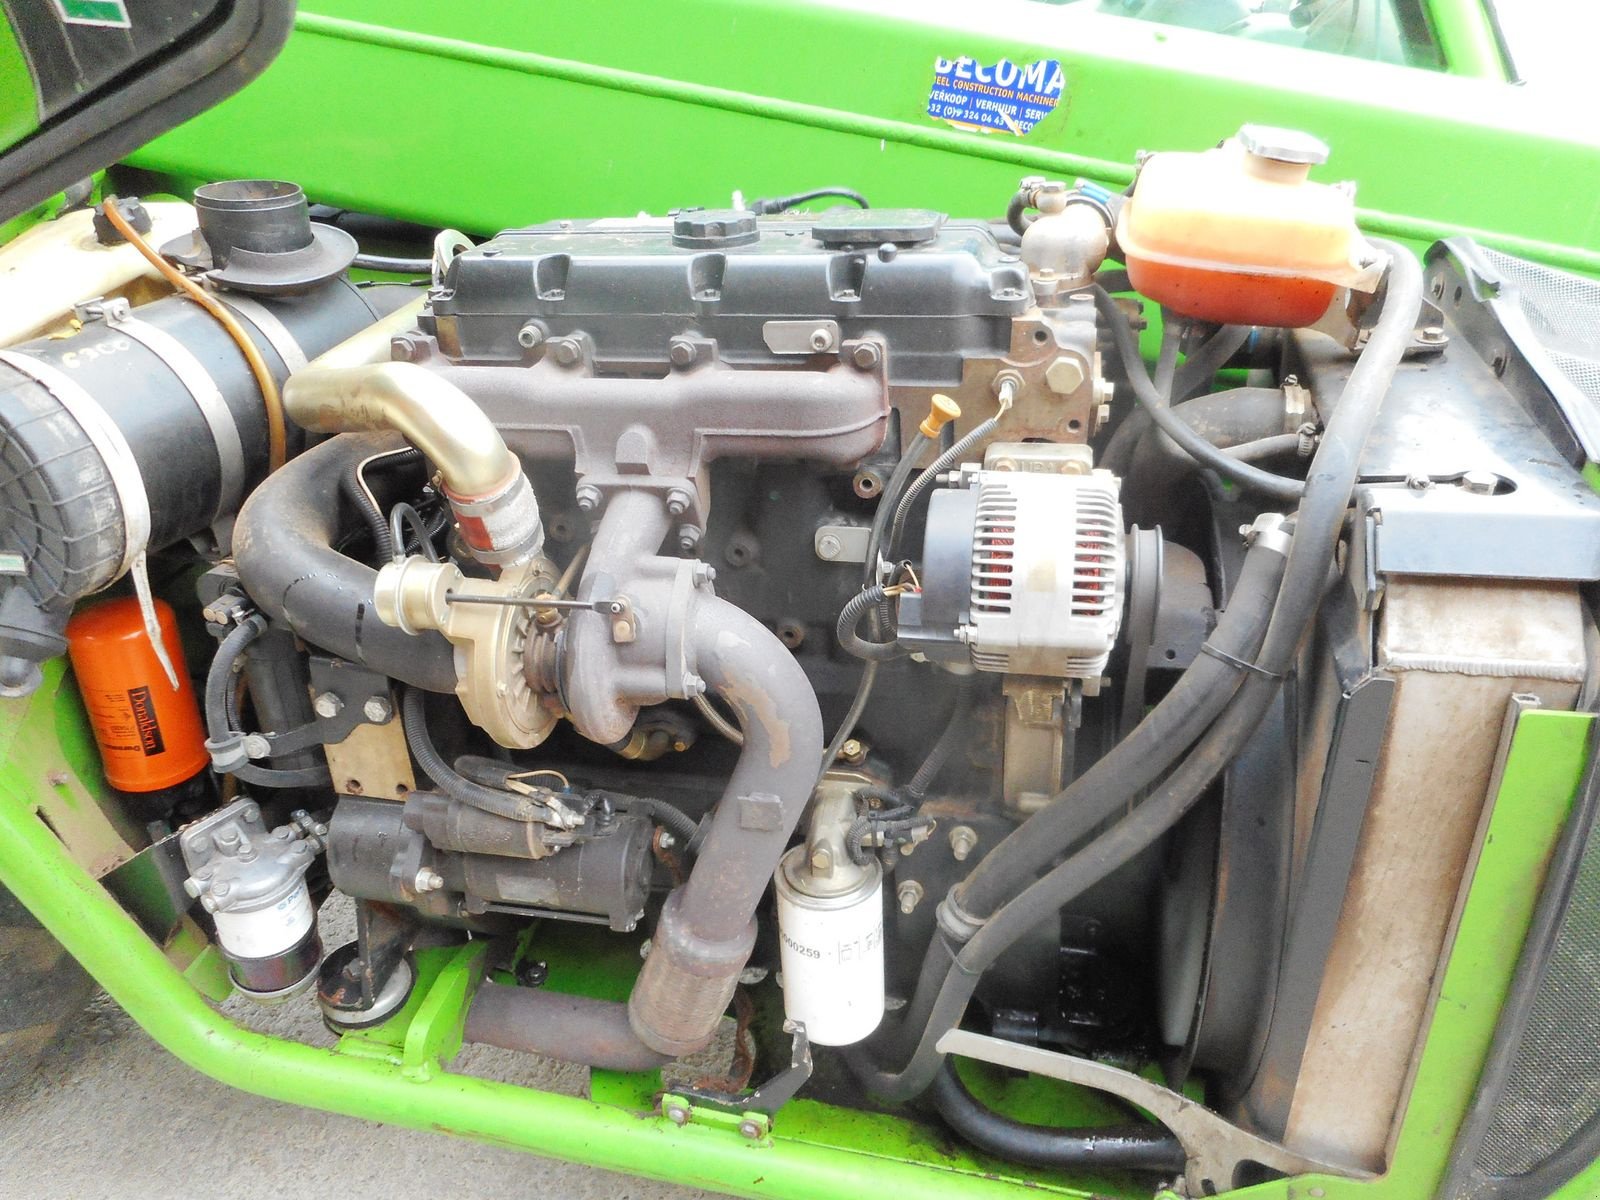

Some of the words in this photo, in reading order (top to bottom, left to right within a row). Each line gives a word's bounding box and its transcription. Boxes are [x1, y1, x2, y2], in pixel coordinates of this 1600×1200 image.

[953, 79, 1014, 99] CONSTRUCTION
[929, 90, 968, 105] VERKOOP
[976, 98, 1017, 116] VERHUUR
[963, 110, 979, 120] 324
[981, 113, 992, 123] 04
[131, 691, 158, 750] Donaldson
